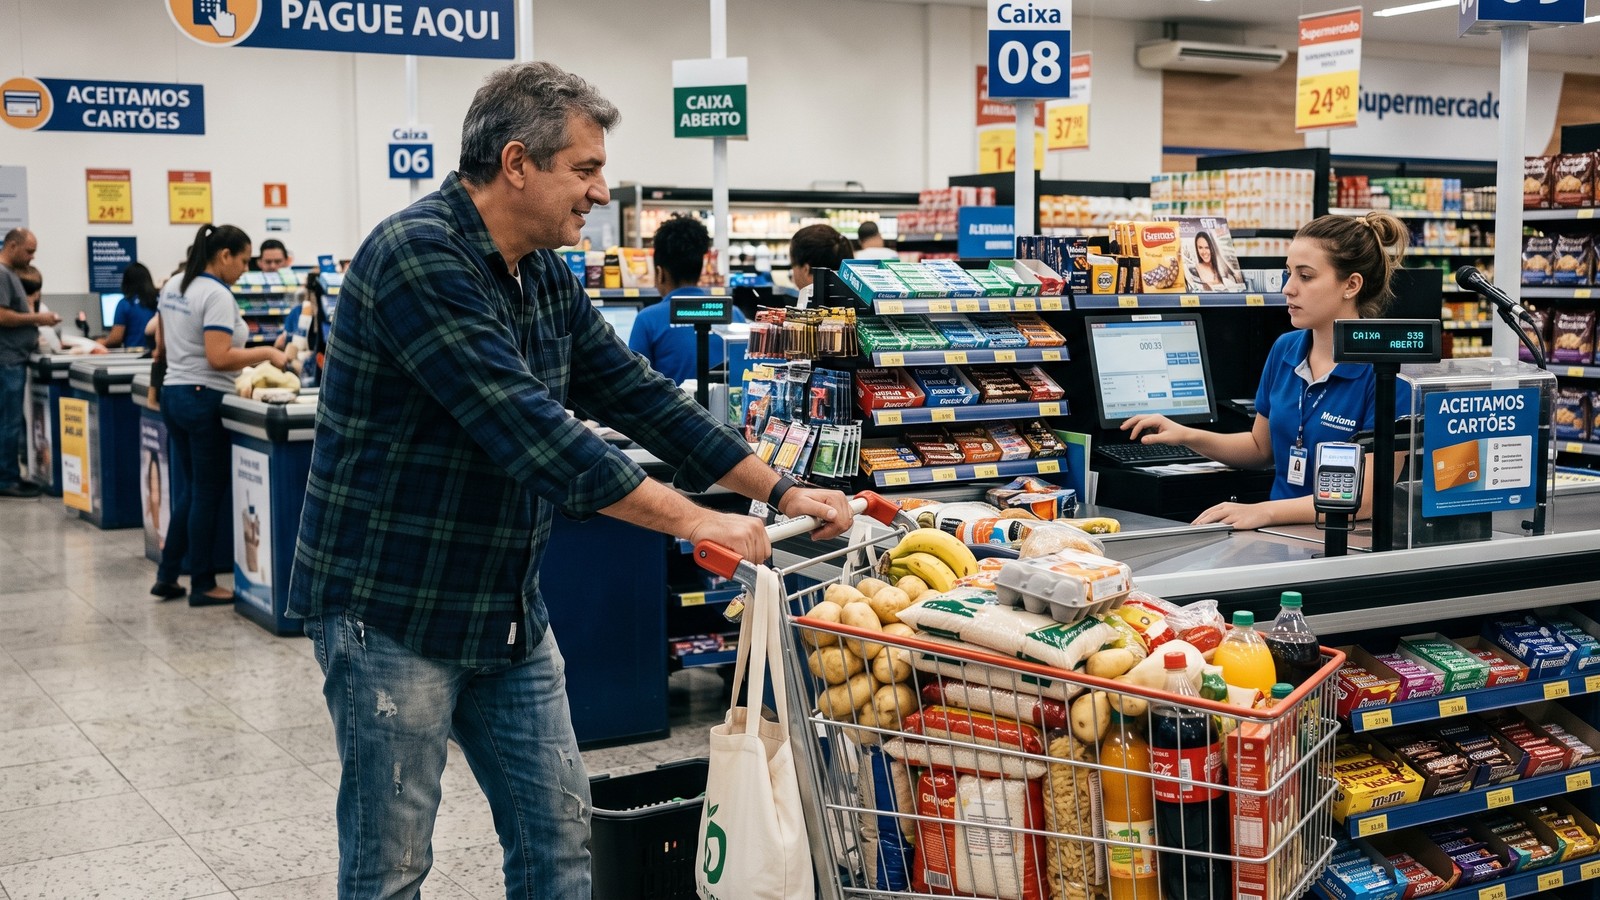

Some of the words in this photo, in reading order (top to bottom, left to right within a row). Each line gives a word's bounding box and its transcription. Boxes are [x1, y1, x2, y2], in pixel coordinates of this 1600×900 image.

[281, 0, 403, 35] PAGUE
[412, 6, 499, 42] AQUI
[997, 3, 1061, 23] Caixa
[1301, 20, 1359, 40] Supermercado
[998, 40, 1061, 85] 08
[66, 86, 190, 107] ACEITAMOS
[686, 95, 734, 110] CAIXA
[82, 107, 180, 130] CARTÕES
[680, 111, 741, 127] ABERTO
[393, 128, 428, 140] Caixa
[393, 147, 430, 174] 06
[1353, 332, 1380, 340] CAIXA
[1390, 341, 1424, 349] ABERTO
[1439, 395, 1524, 414] ACEITAMOS
[1321, 411, 1356, 427] Mariana
[1447, 413, 1516, 434] CARTÕES
